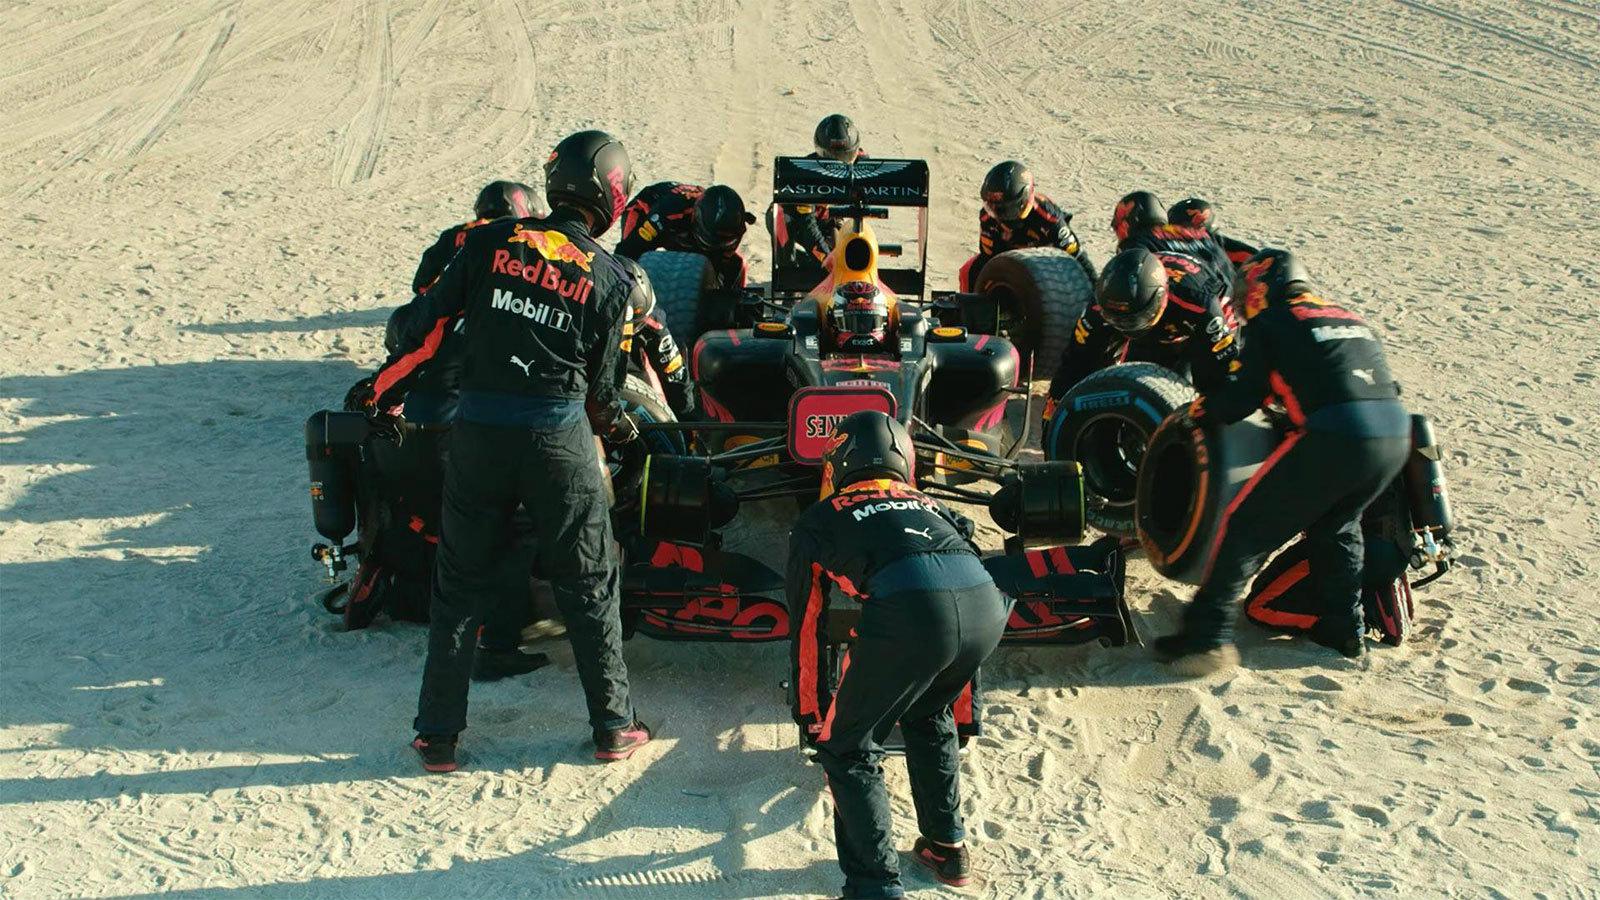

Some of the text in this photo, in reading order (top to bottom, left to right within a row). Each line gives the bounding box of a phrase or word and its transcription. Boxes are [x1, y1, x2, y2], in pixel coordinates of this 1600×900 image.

[781, 184, 846, 195] ASTON
[492, 249, 595, 305] Red Bull
[491, 288, 551, 325] Mobil
[852, 500, 921, 521] Mobil
